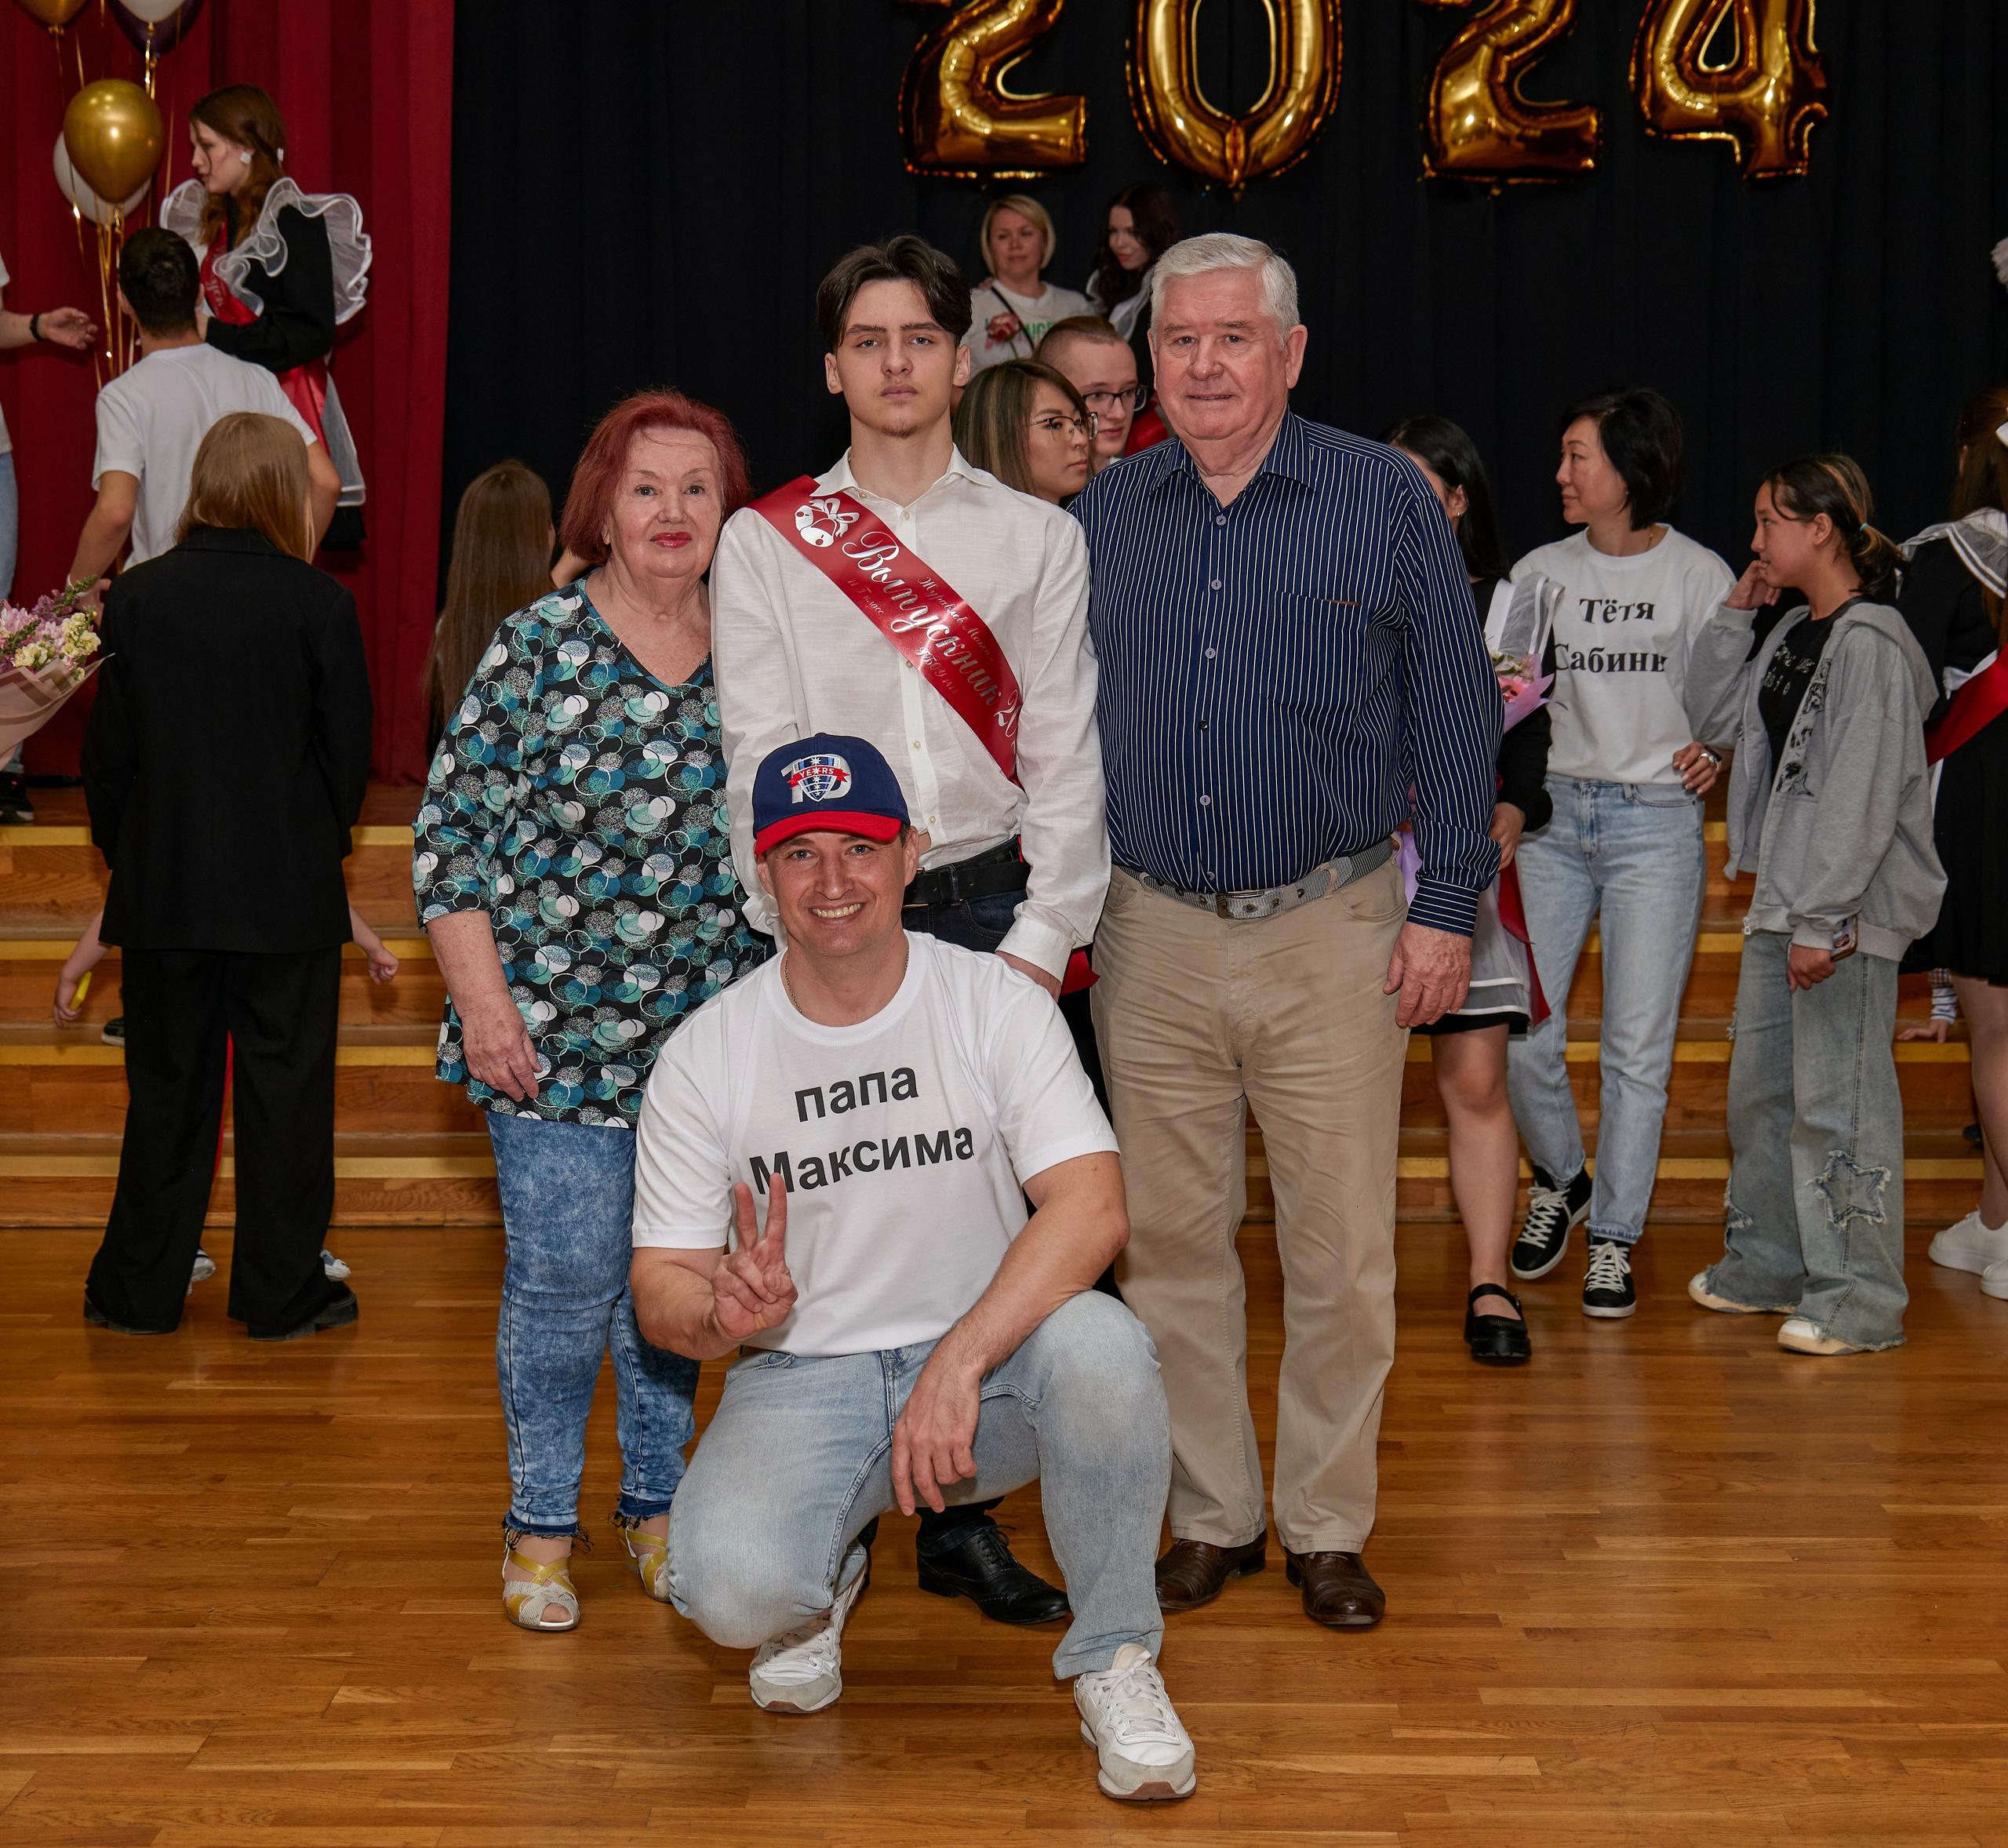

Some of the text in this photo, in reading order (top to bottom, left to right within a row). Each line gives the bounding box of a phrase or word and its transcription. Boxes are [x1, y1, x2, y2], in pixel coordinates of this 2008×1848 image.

[842, 531, 1001, 706] Выпускник
[1579, 598, 1655, 624] Тётя
[795, 1067, 919, 1122] папа
[749, 1126, 975, 1195] Максима
